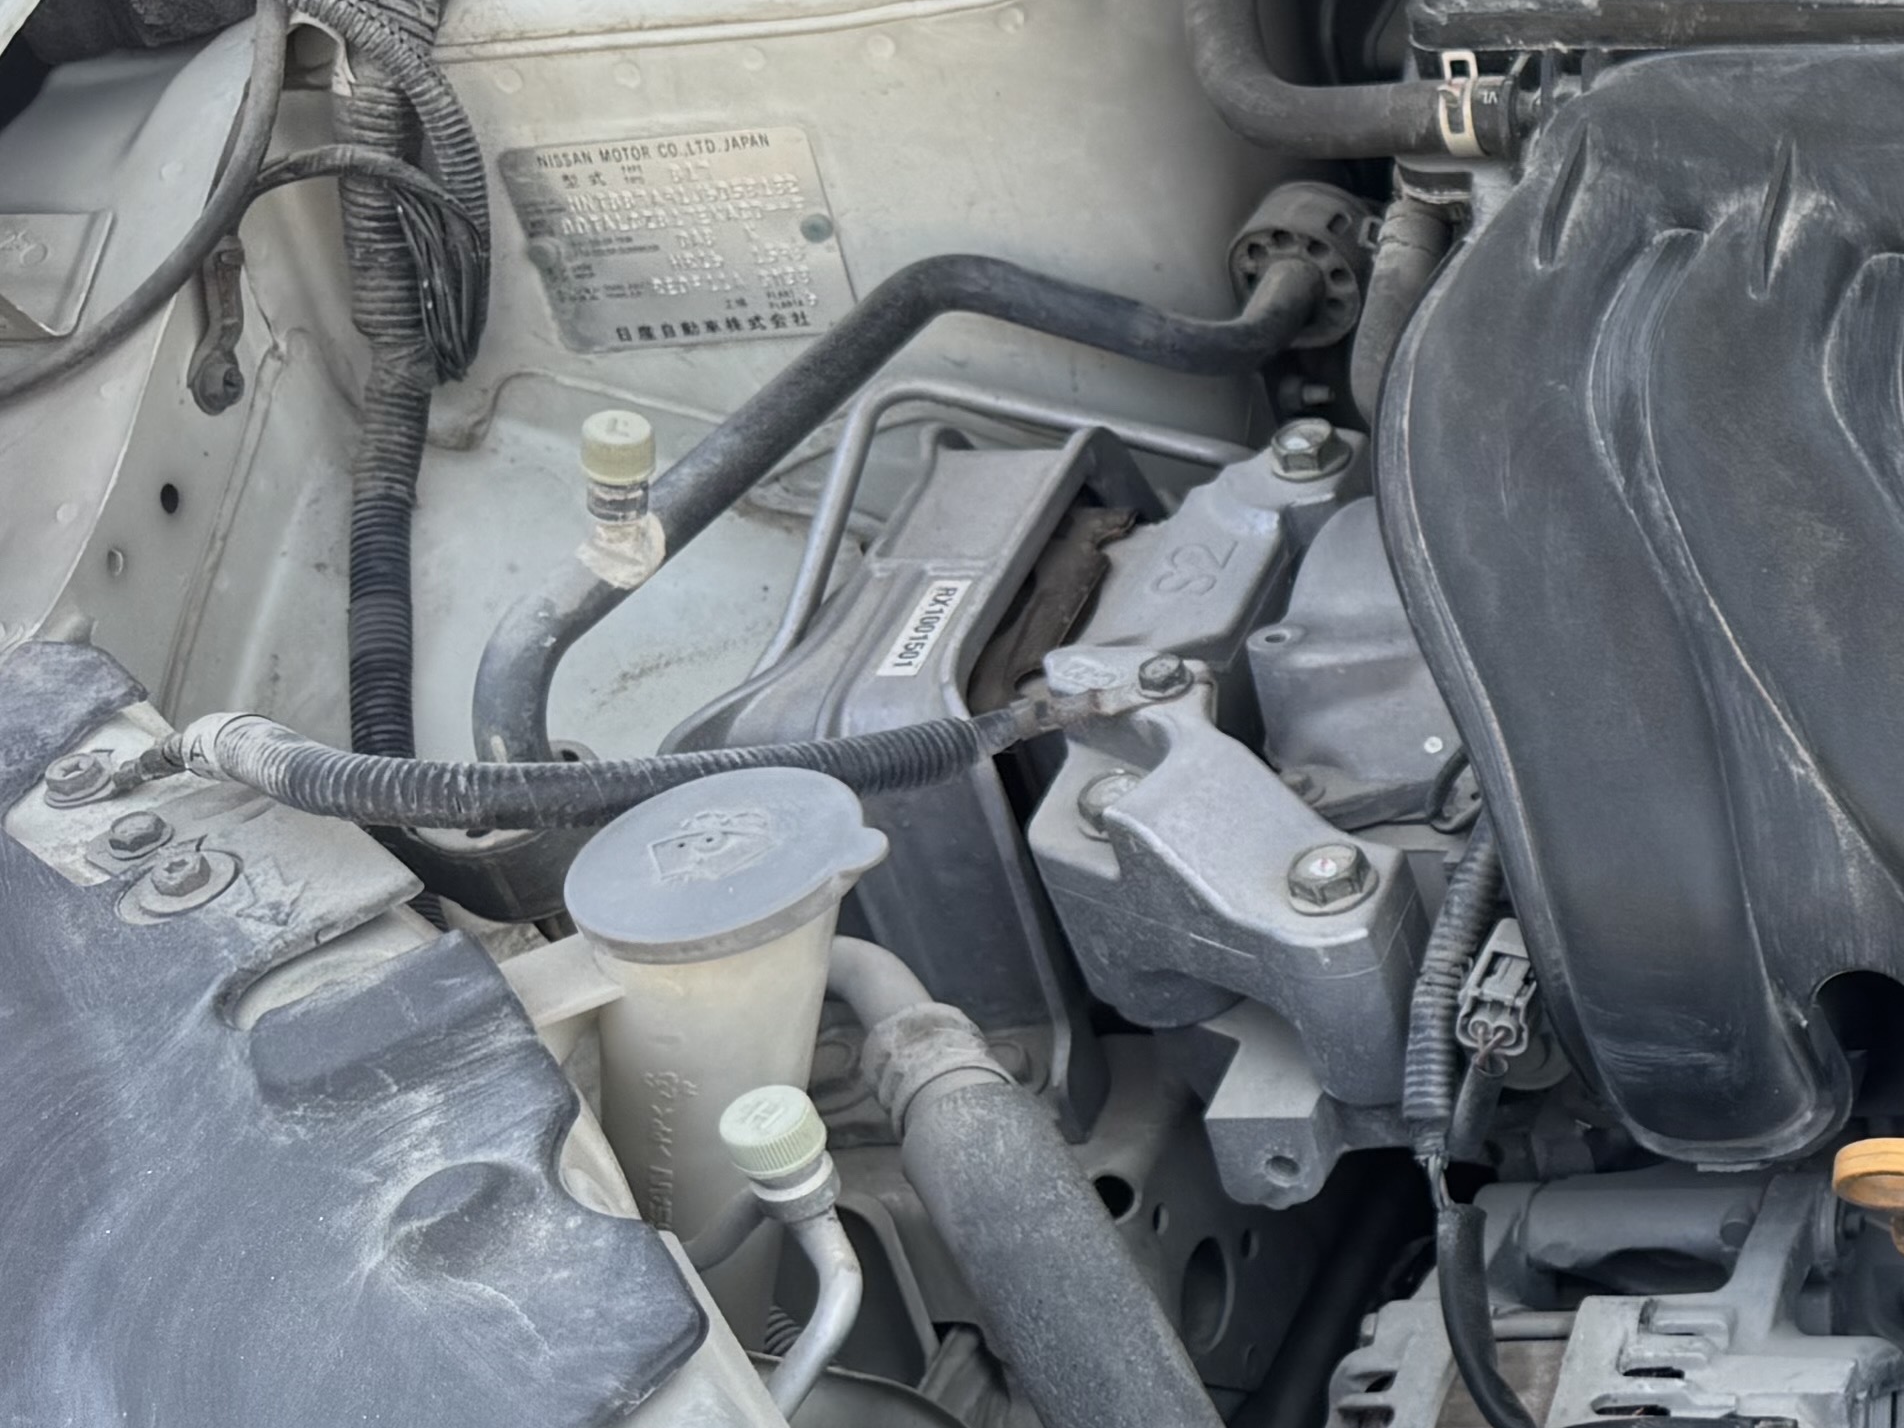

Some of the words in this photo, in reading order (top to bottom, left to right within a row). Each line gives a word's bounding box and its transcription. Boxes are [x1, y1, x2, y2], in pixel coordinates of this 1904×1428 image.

[536, 149, 593, 169] NISSAN
[599, 143, 652, 163] MOTOR
[615, 310, 812, 343] 日産自動車株式会社
[888, 583, 962, 671] RX1001501
